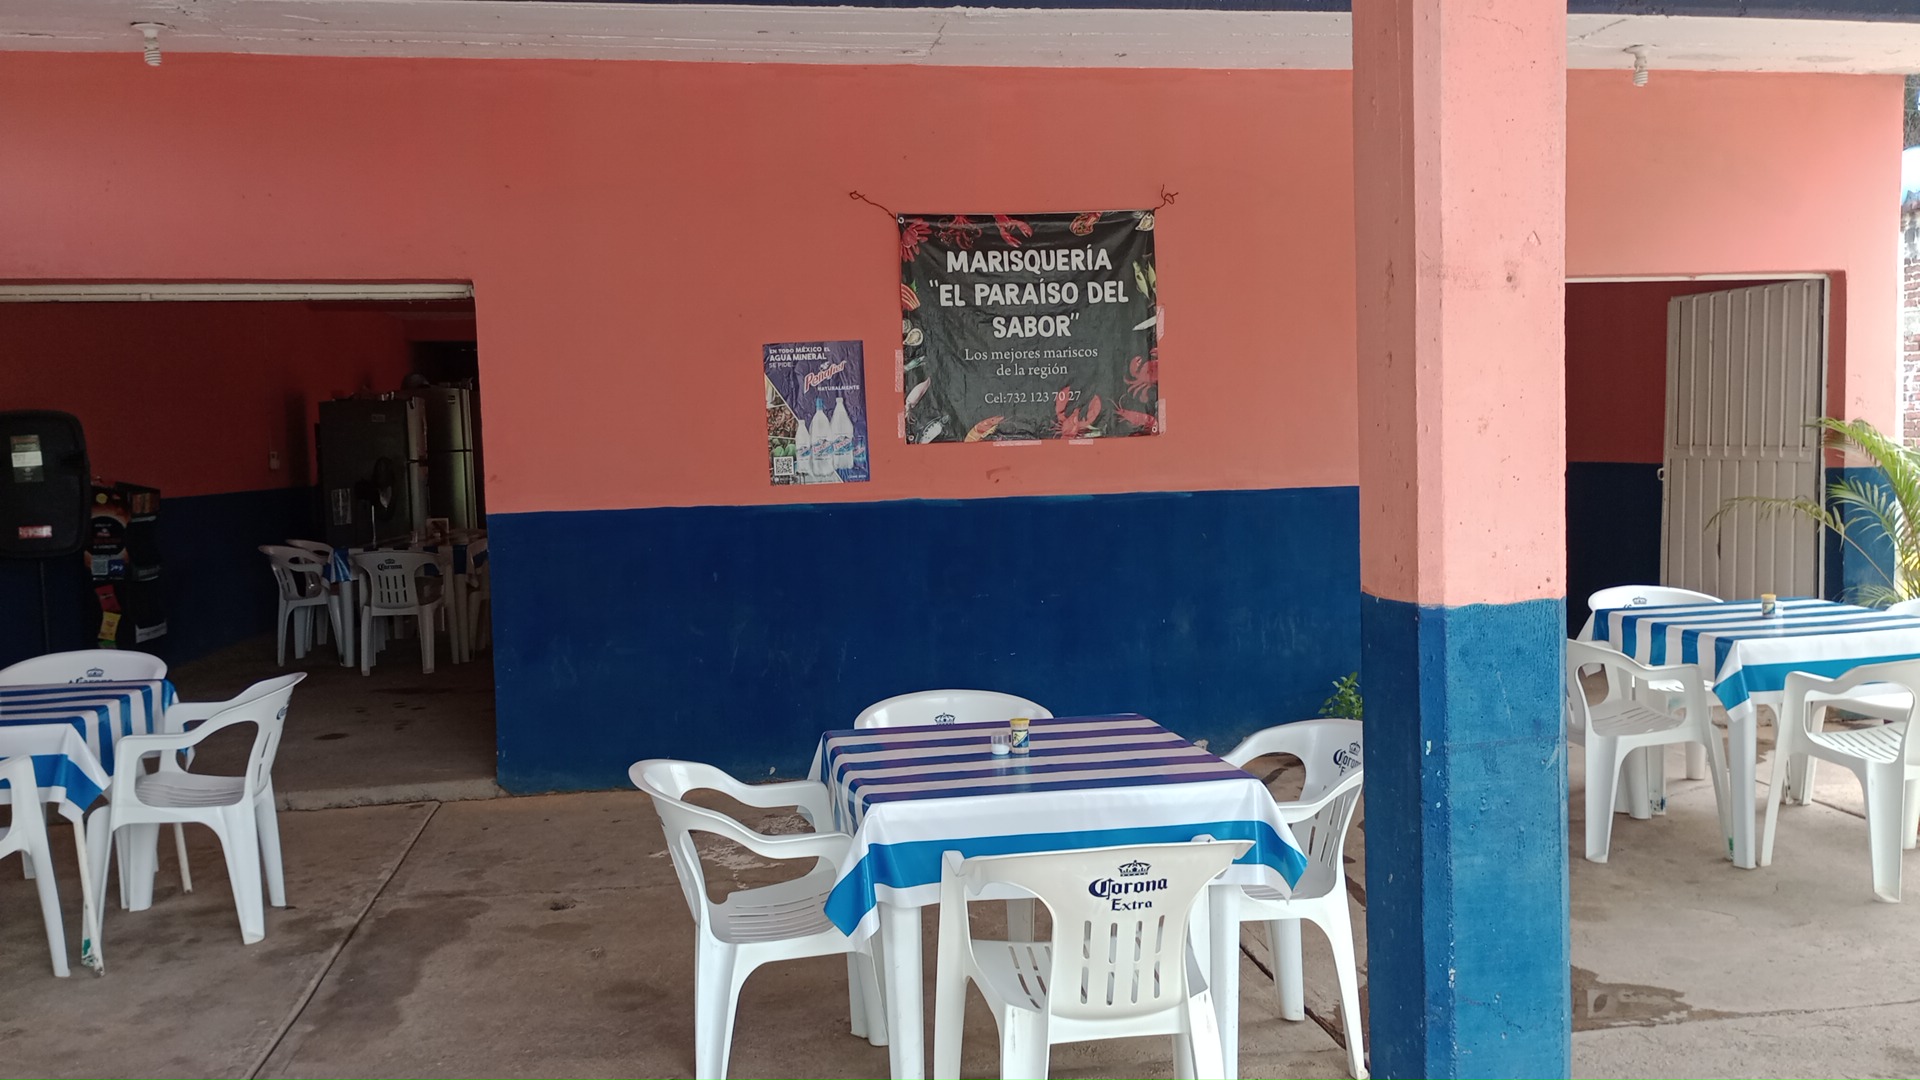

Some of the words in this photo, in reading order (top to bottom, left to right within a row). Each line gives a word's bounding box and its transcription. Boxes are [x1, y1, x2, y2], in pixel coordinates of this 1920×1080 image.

[947, 244, 1112, 274] MARISQUERÍA
[974, 278, 1079, 306] PARAÍSO
[1087, 280, 1129, 304] DEL
[992, 312, 1080, 339] SABOR"
[769, 354, 792, 362] AGUA
[792, 353, 827, 361] MINERAL
[964, 348, 988, 360] Los
[991, 347, 1041, 364] mejores
[1043, 346, 1098, 358] mariscos
[996, 363, 1012, 376] de
[1014, 363, 1026, 376] la
[1028, 363, 1068, 379] región
[1030, 391, 1050, 403] 123
[1052, 391, 1066, 402] 70
[1068, 391, 1081, 401] 27
[1088, 878, 1168, 900] Corona
[1111, 898, 1153, 911] Extra
